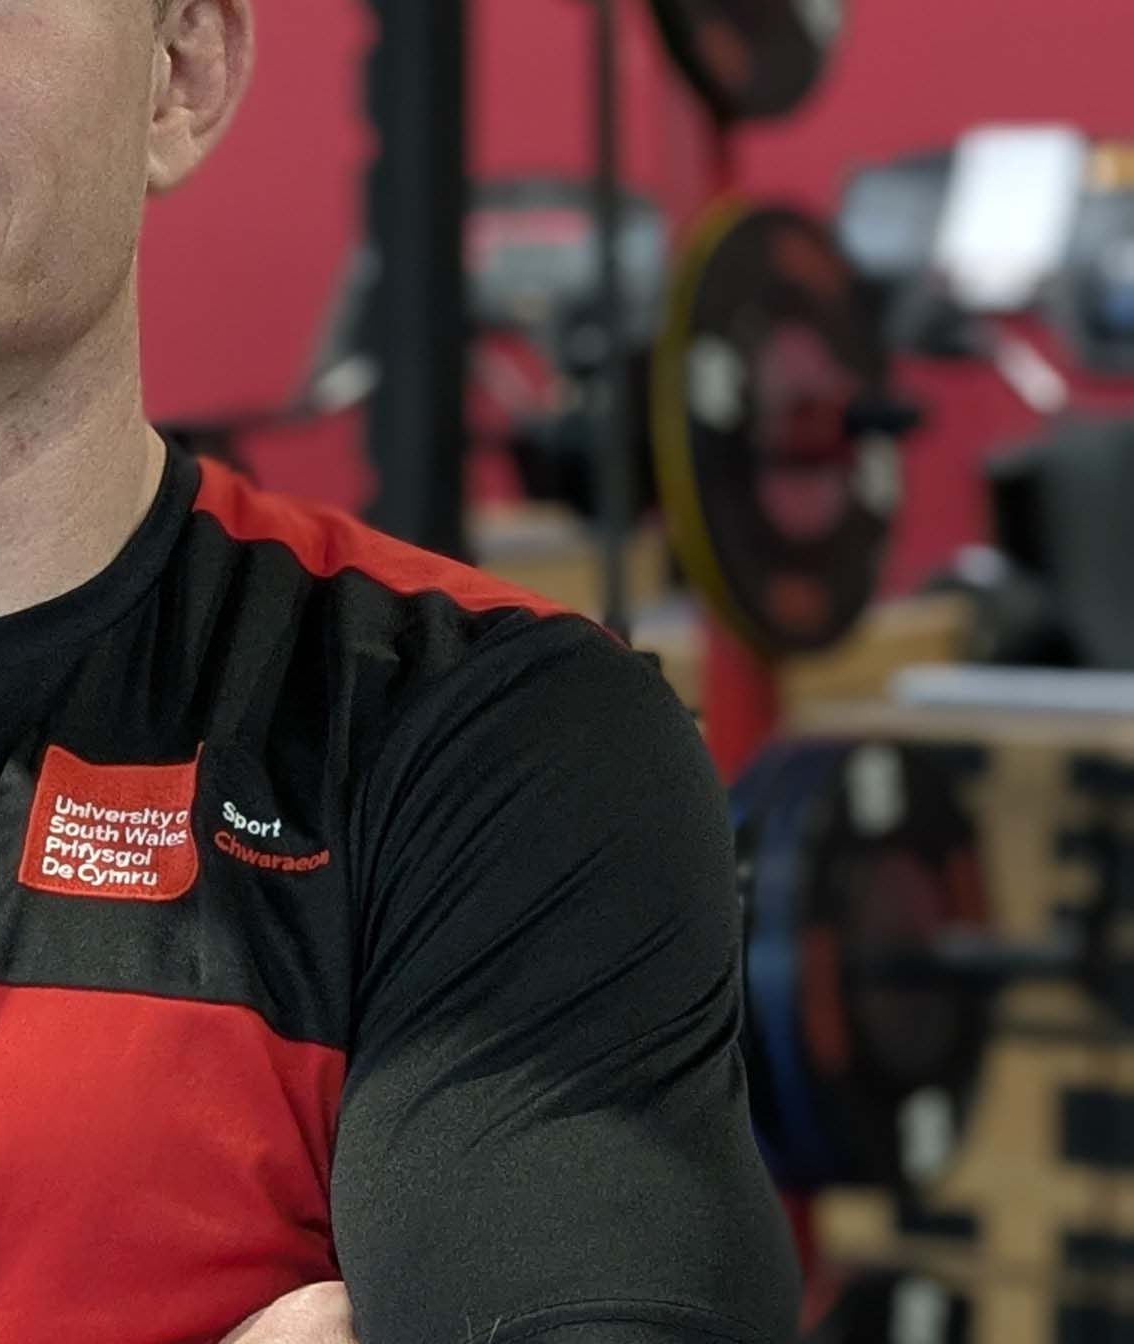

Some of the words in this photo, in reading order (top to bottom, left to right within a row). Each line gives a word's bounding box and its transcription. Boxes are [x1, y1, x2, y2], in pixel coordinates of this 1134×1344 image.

[54, 794, 173, 829] University
[222, 800, 282, 838] Sport
[49, 815, 120, 843] South
[124, 826, 188, 847] Wales
[44, 835, 153, 868] Prifysgol
[41, 855, 74, 880] De
[77, 862, 157, 886] Cymru
